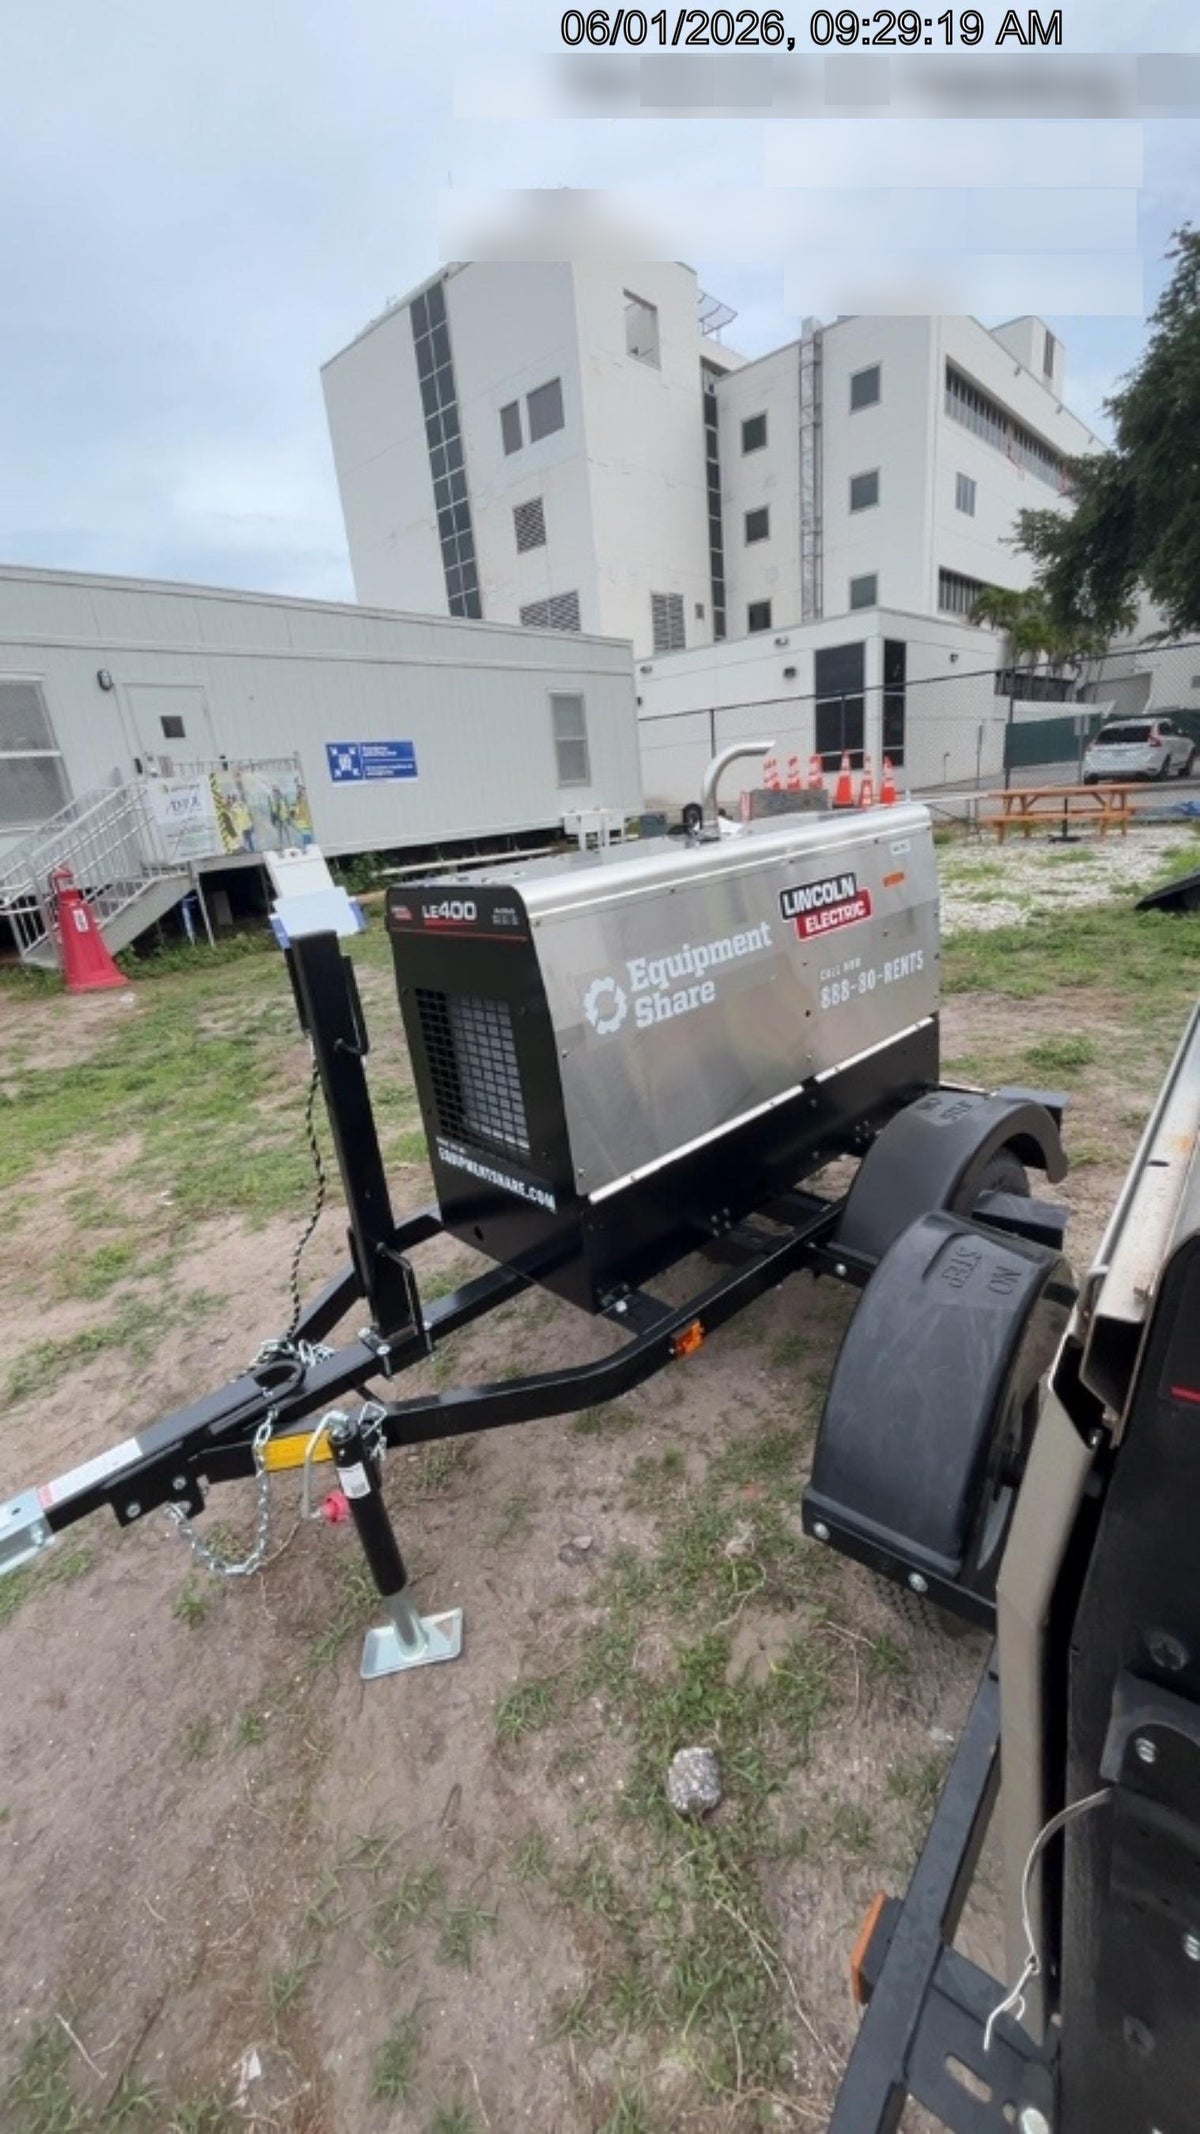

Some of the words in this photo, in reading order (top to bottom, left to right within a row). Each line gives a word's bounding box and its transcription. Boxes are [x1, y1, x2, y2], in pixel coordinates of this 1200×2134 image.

[421, 900, 477, 921] LE400
[782, 877, 856, 915] LINCOLN
[805, 900, 867, 933] ELECTRIC
[626, 921, 773, 992] Equipment
[820, 949, 924, 1010] 888-80-RENTS
[635, 980, 717, 1029] Share
[986, 1264, 1027, 1296] NO
